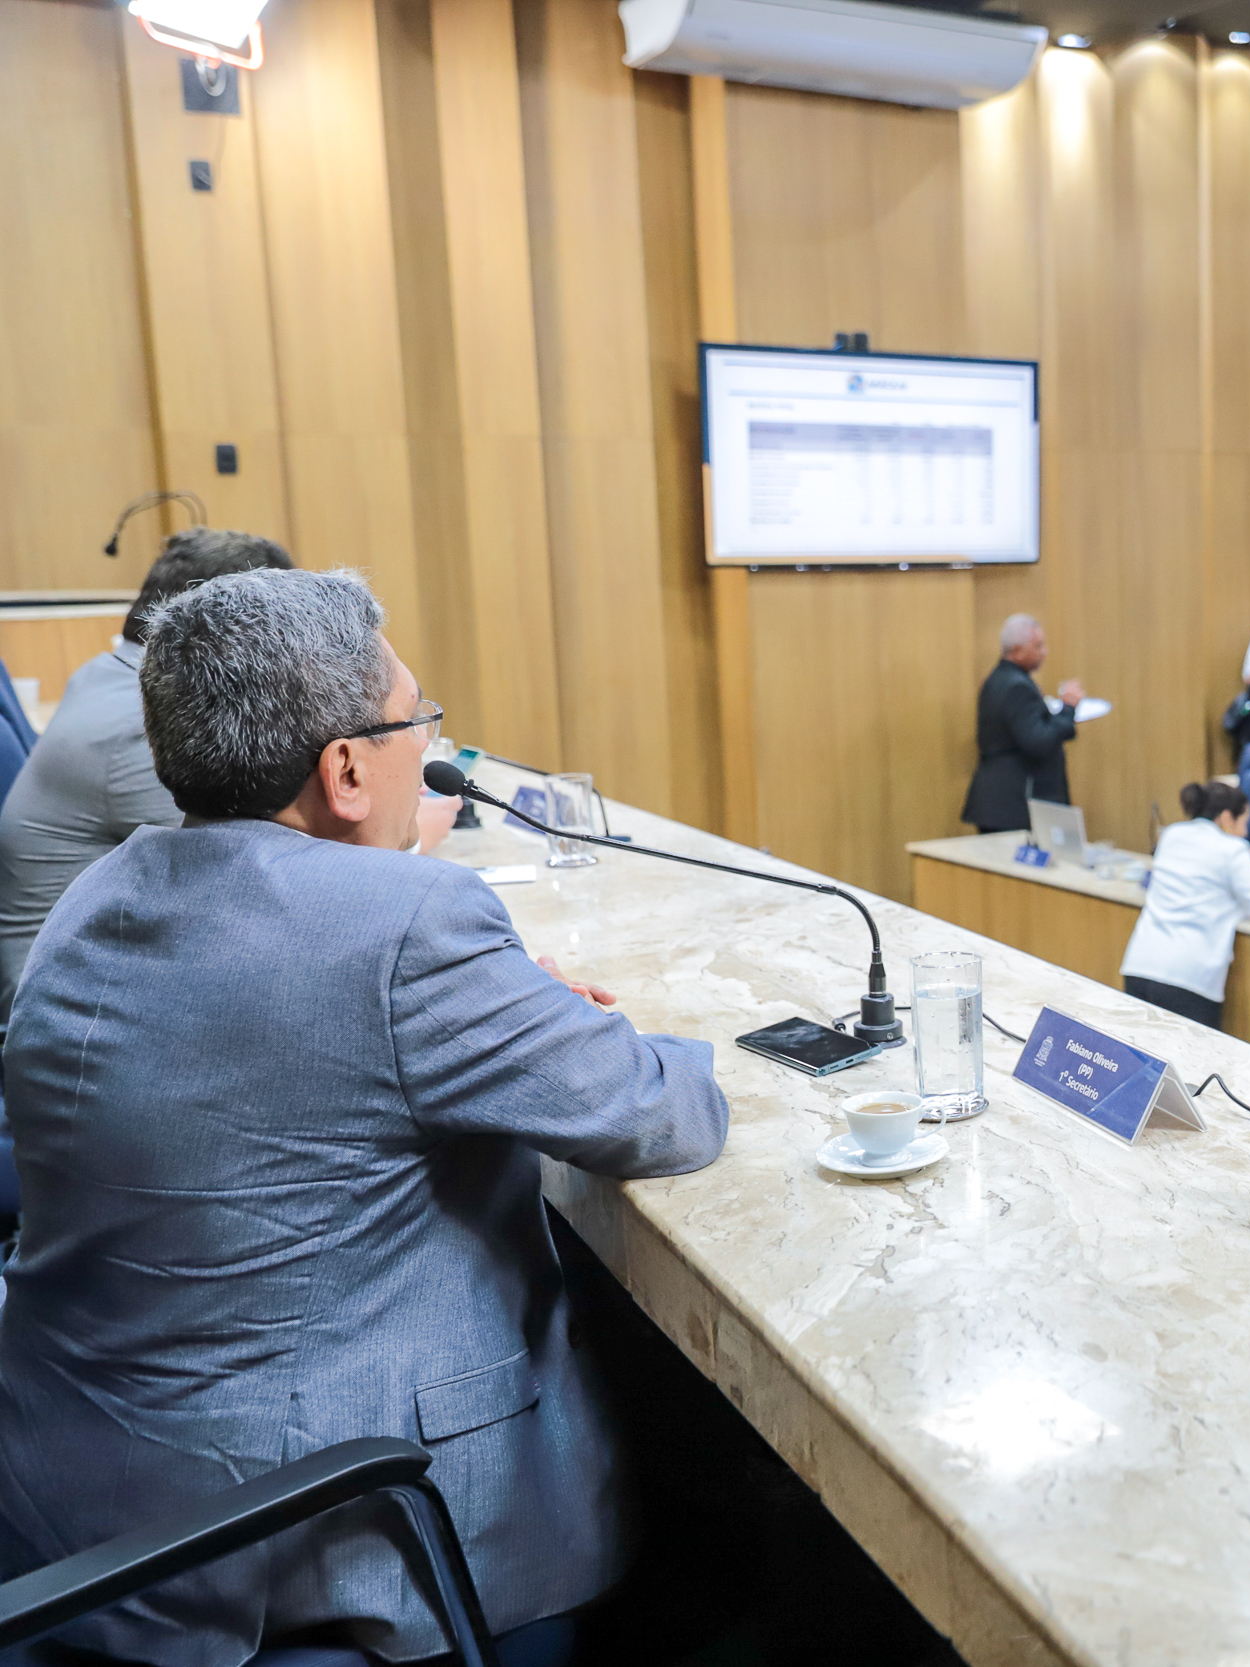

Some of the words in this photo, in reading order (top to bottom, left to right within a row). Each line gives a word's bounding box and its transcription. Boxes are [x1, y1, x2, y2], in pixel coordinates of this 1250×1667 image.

[1066, 1039, 1093, 1060] Fabiano
[1092, 1052, 1119, 1073] Oliveira
[1077, 1063, 1094, 1080] (PP)
[1065, 1075, 1099, 1101] Secretário
